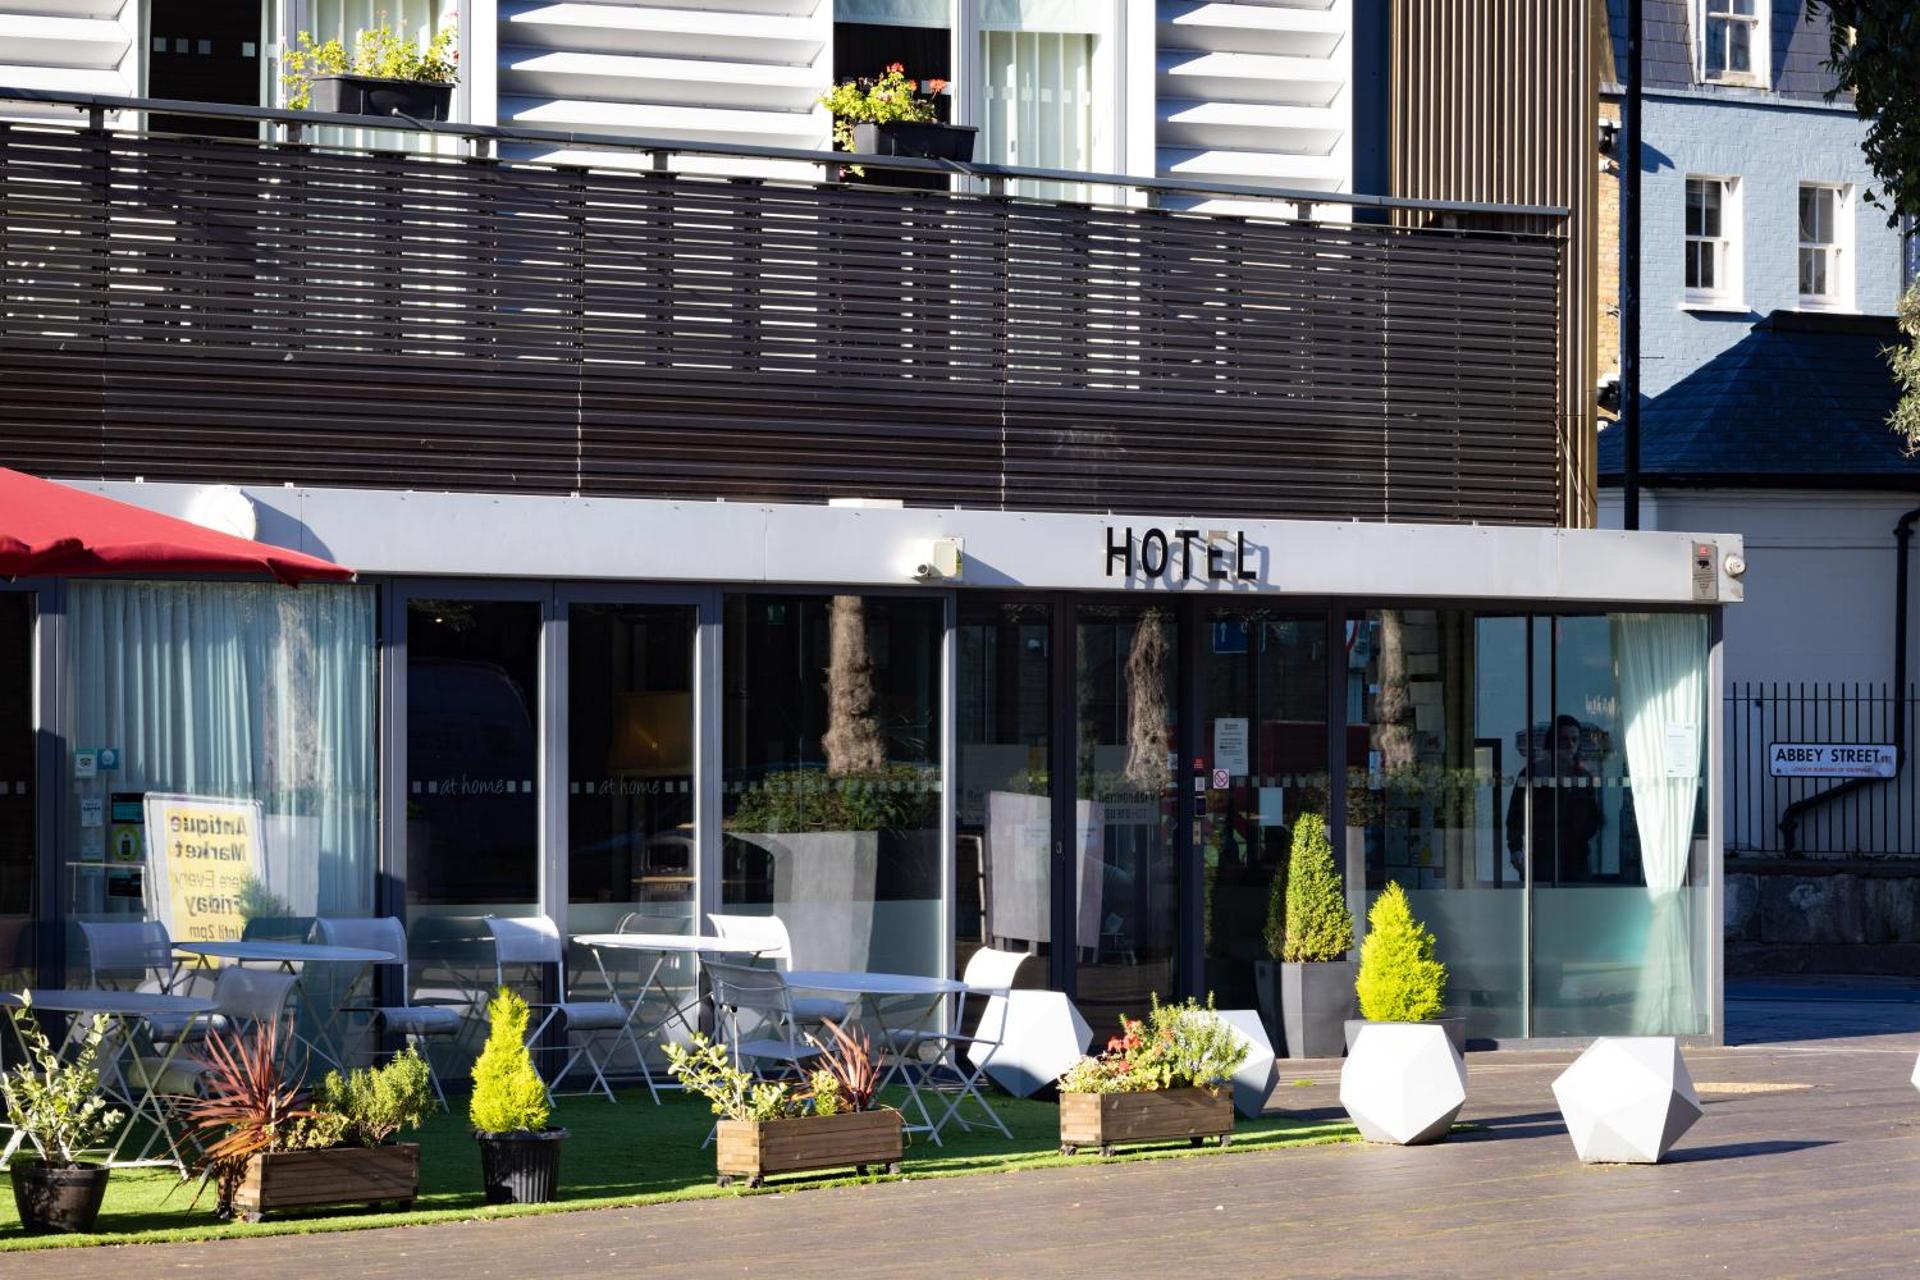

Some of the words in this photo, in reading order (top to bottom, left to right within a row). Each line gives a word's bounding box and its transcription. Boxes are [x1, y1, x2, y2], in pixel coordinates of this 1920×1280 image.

[1106, 527, 1257, 580] HOTEL
[1775, 748, 1823, 762] ABBEY
[1831, 748, 1880, 763] STREET
[461, 772, 505, 795] home
